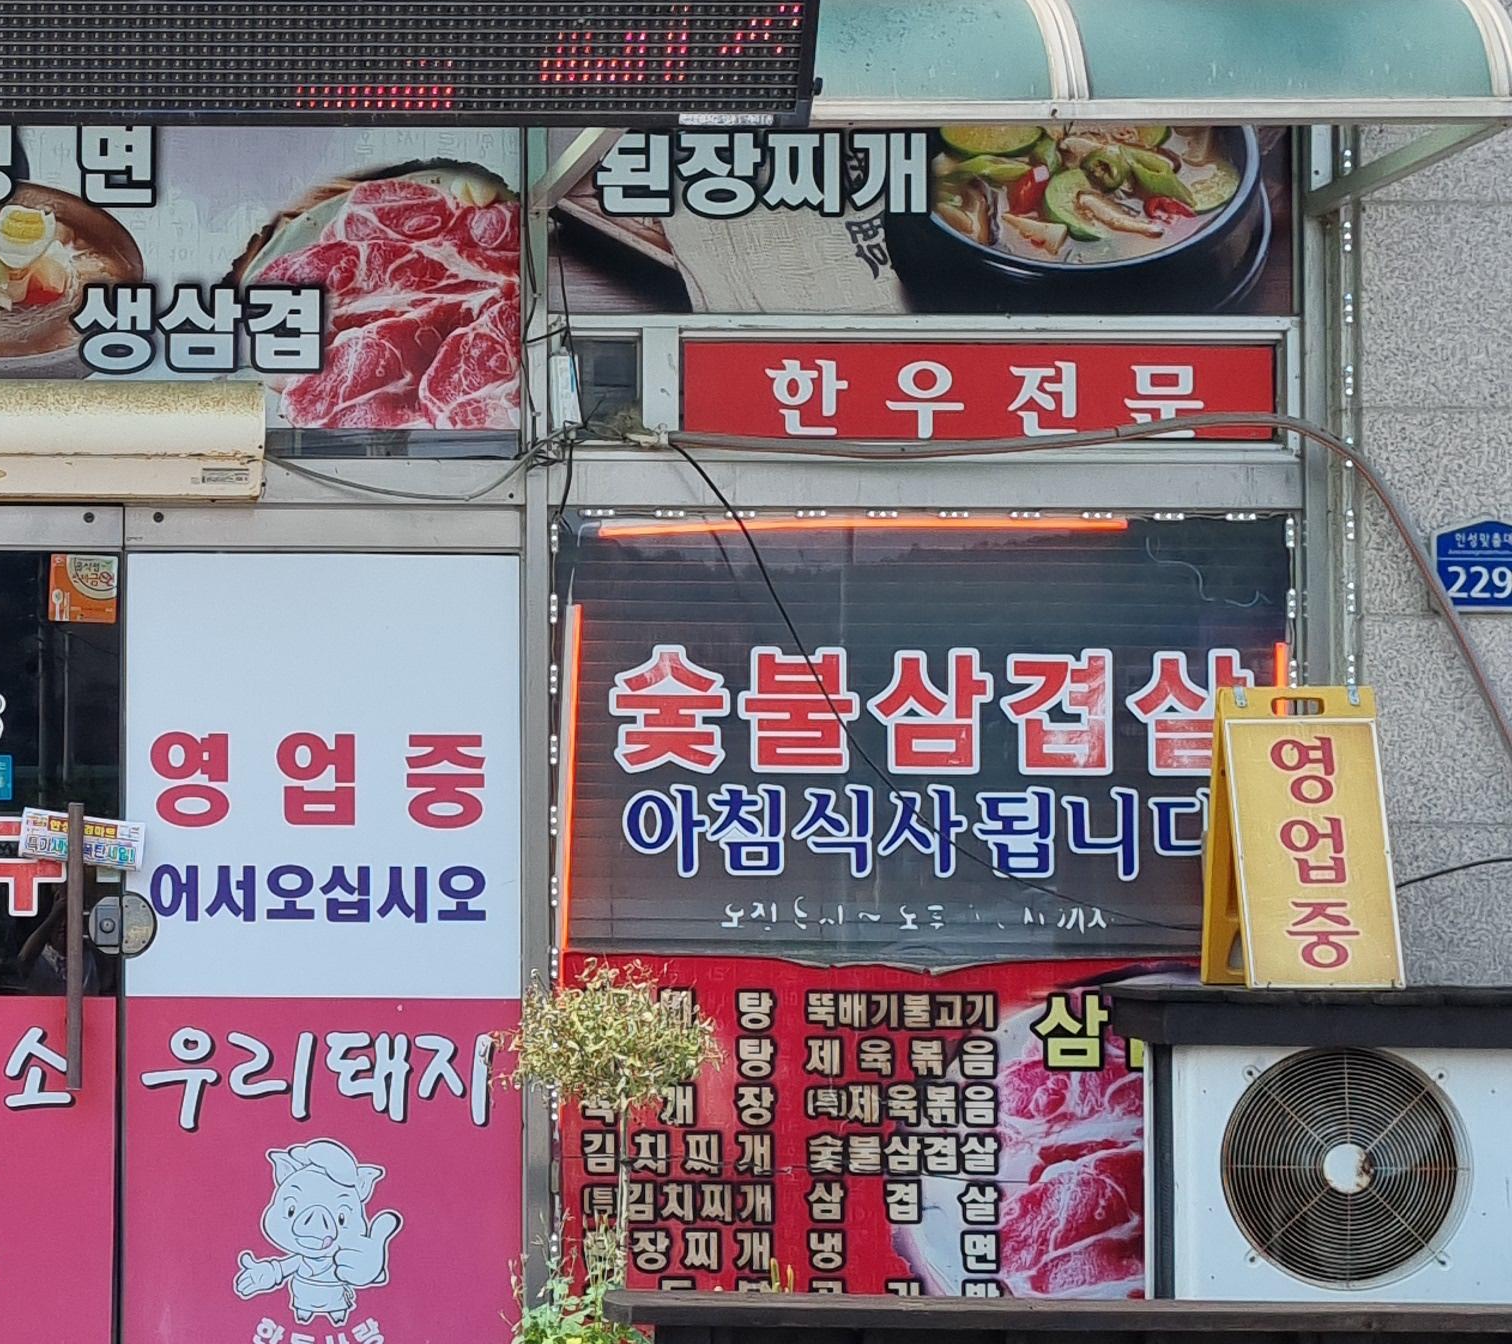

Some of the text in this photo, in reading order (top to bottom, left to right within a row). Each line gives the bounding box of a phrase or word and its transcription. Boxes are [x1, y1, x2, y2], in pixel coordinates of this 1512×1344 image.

[595, 130, 930, 218] 된장찌개
[71, 282, 327, 375] 생삼겹
[1447, 565, 1512, 599] 229
[608, 643, 1255, 776] 숯불삼겹살
[1268, 732, 1363, 971] 영업중
[149, 863, 488, 924] 어서오십시오
[806, 991, 996, 1030] 뚝배기불고기
[582, 1131, 773, 1176] 김치찌개
[807, 1134, 999, 1174] 숯불삼겹살
